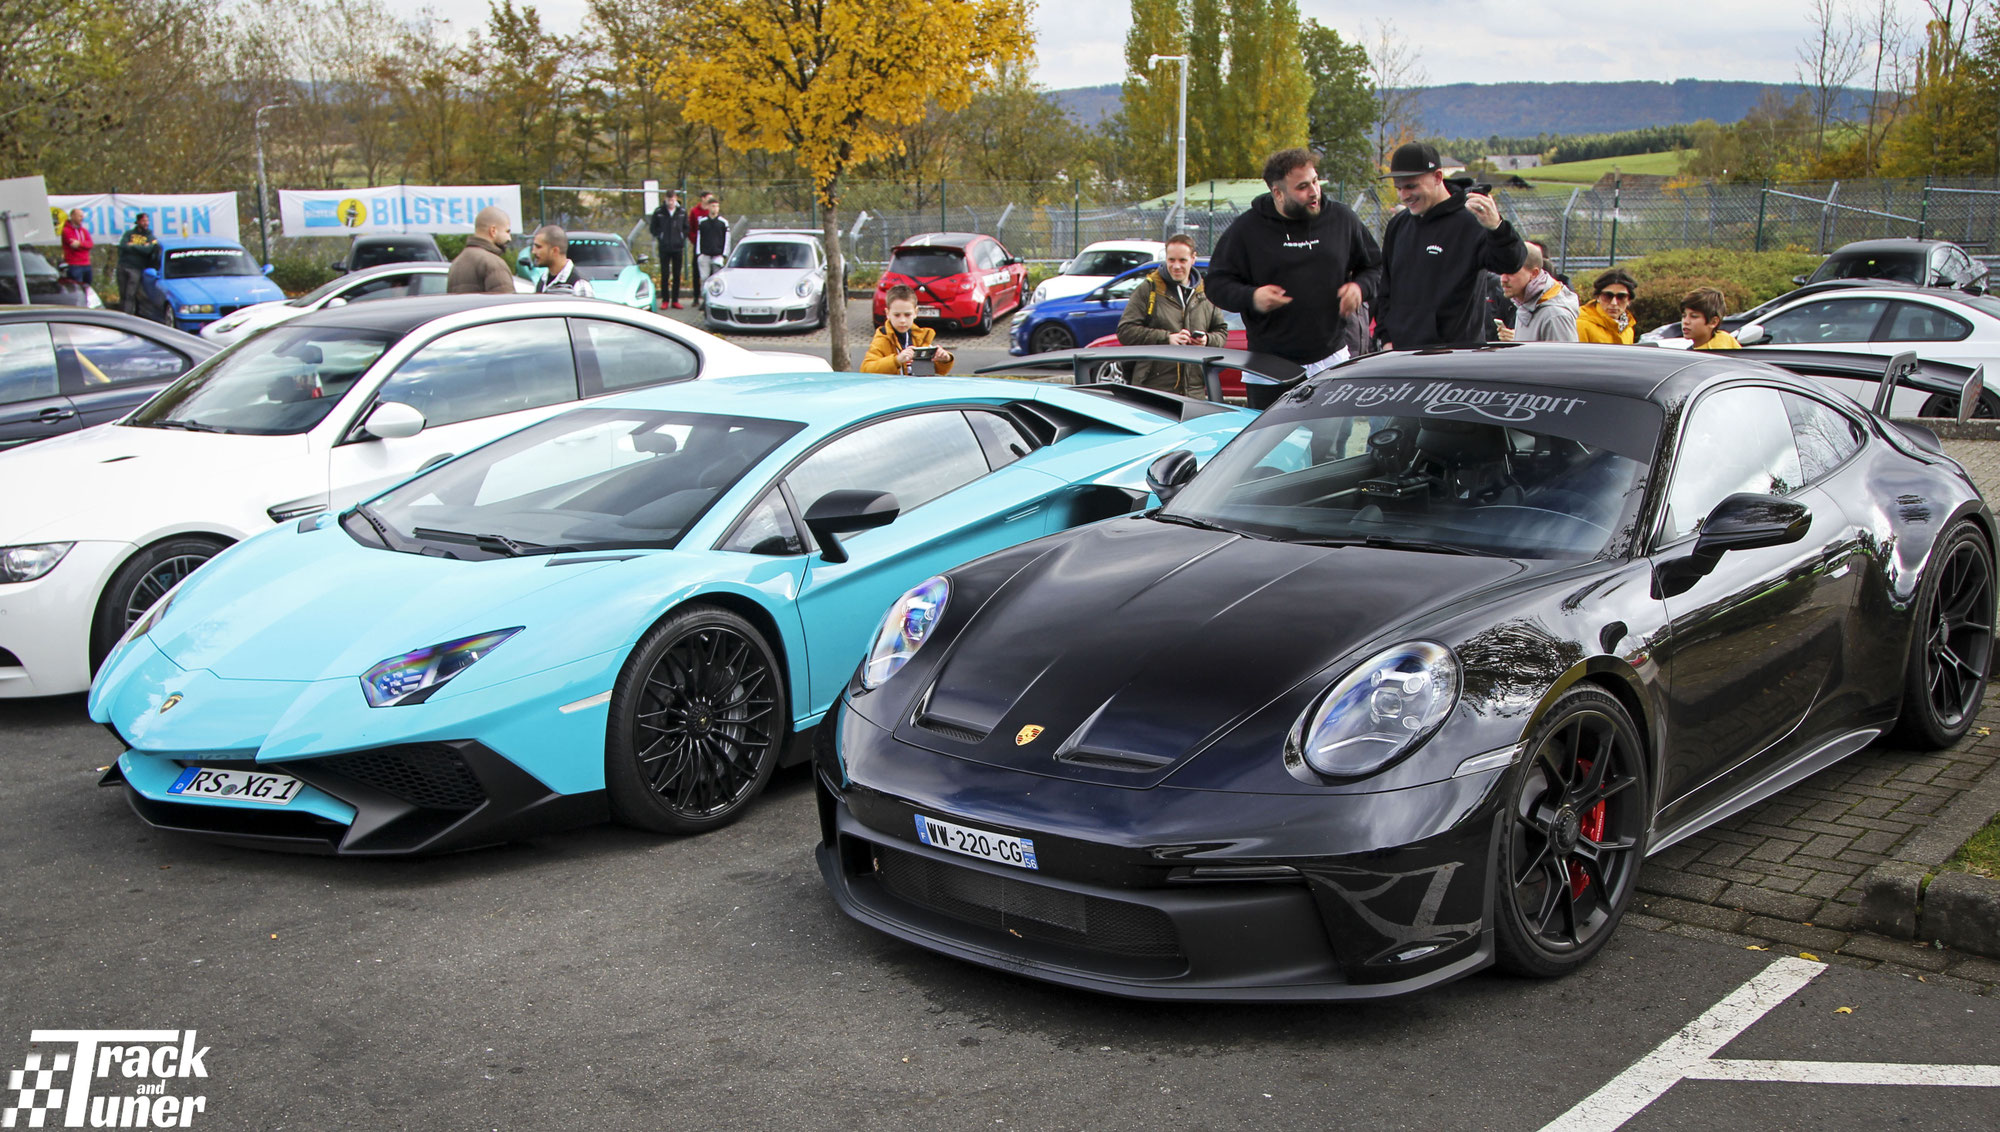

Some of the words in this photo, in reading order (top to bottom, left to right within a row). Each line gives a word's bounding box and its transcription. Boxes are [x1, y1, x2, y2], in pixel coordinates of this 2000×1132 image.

[1323, 382, 1413, 408] Breizh
[1414, 382, 1587, 421] Motorsport
[186, 771, 230, 793] RS
[234, 775, 278, 797] XG
[273, 780, 297, 799] 1
[926, 822, 1022, 862] WW-220-CG
